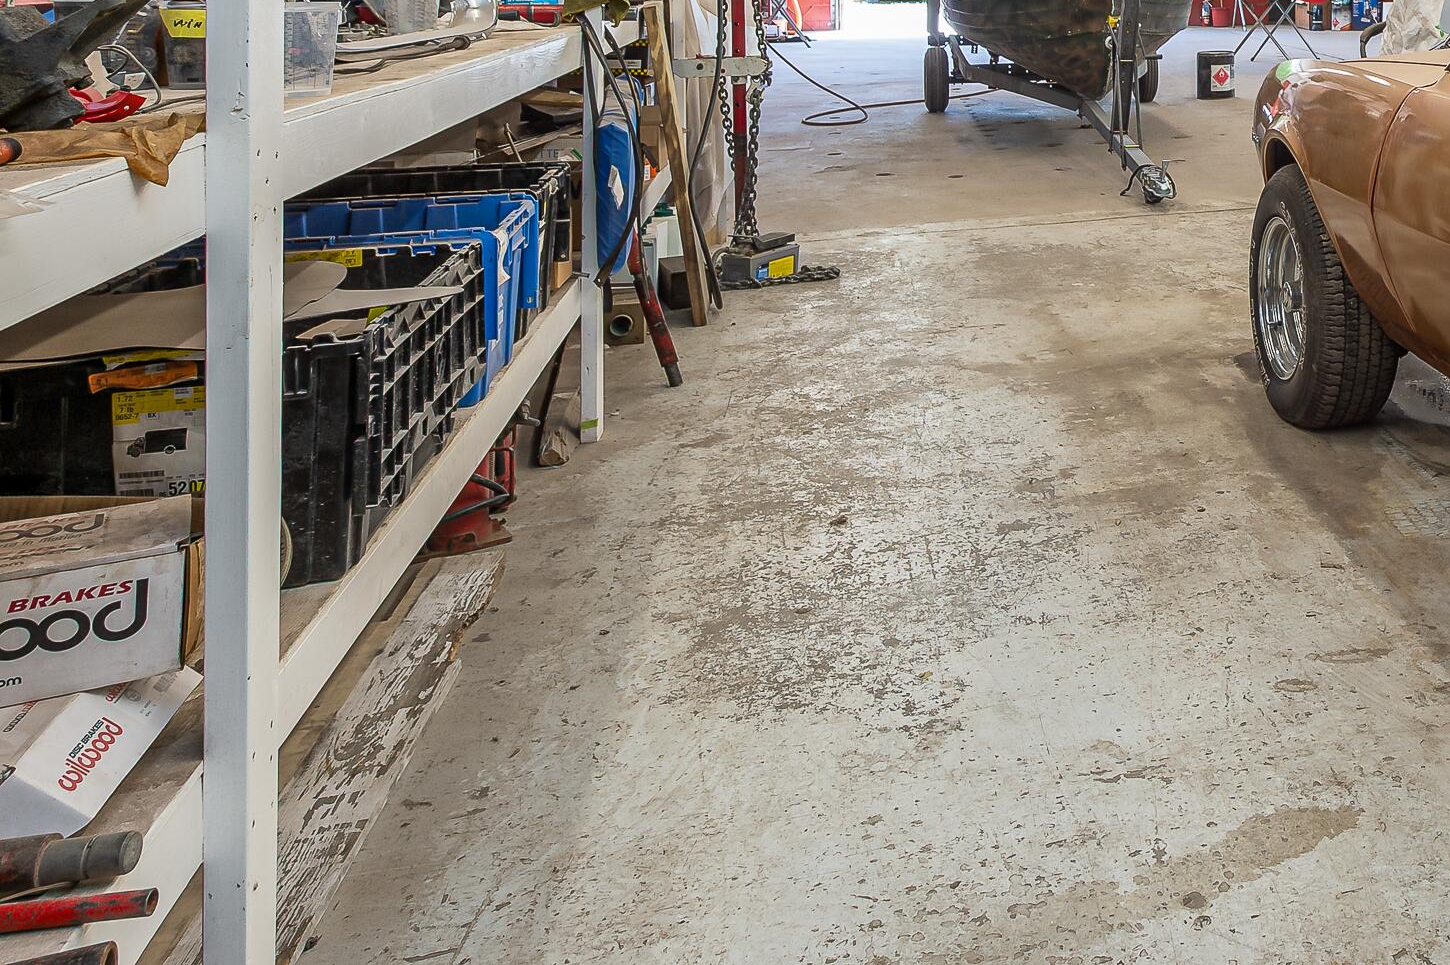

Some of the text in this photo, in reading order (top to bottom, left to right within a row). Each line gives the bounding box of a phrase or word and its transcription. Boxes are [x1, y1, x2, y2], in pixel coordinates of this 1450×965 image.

[6, 579, 134, 615] BRAKES
[57, 716, 125, 792] wilwood
[68, 719, 105, 759] DISC BRAKES
